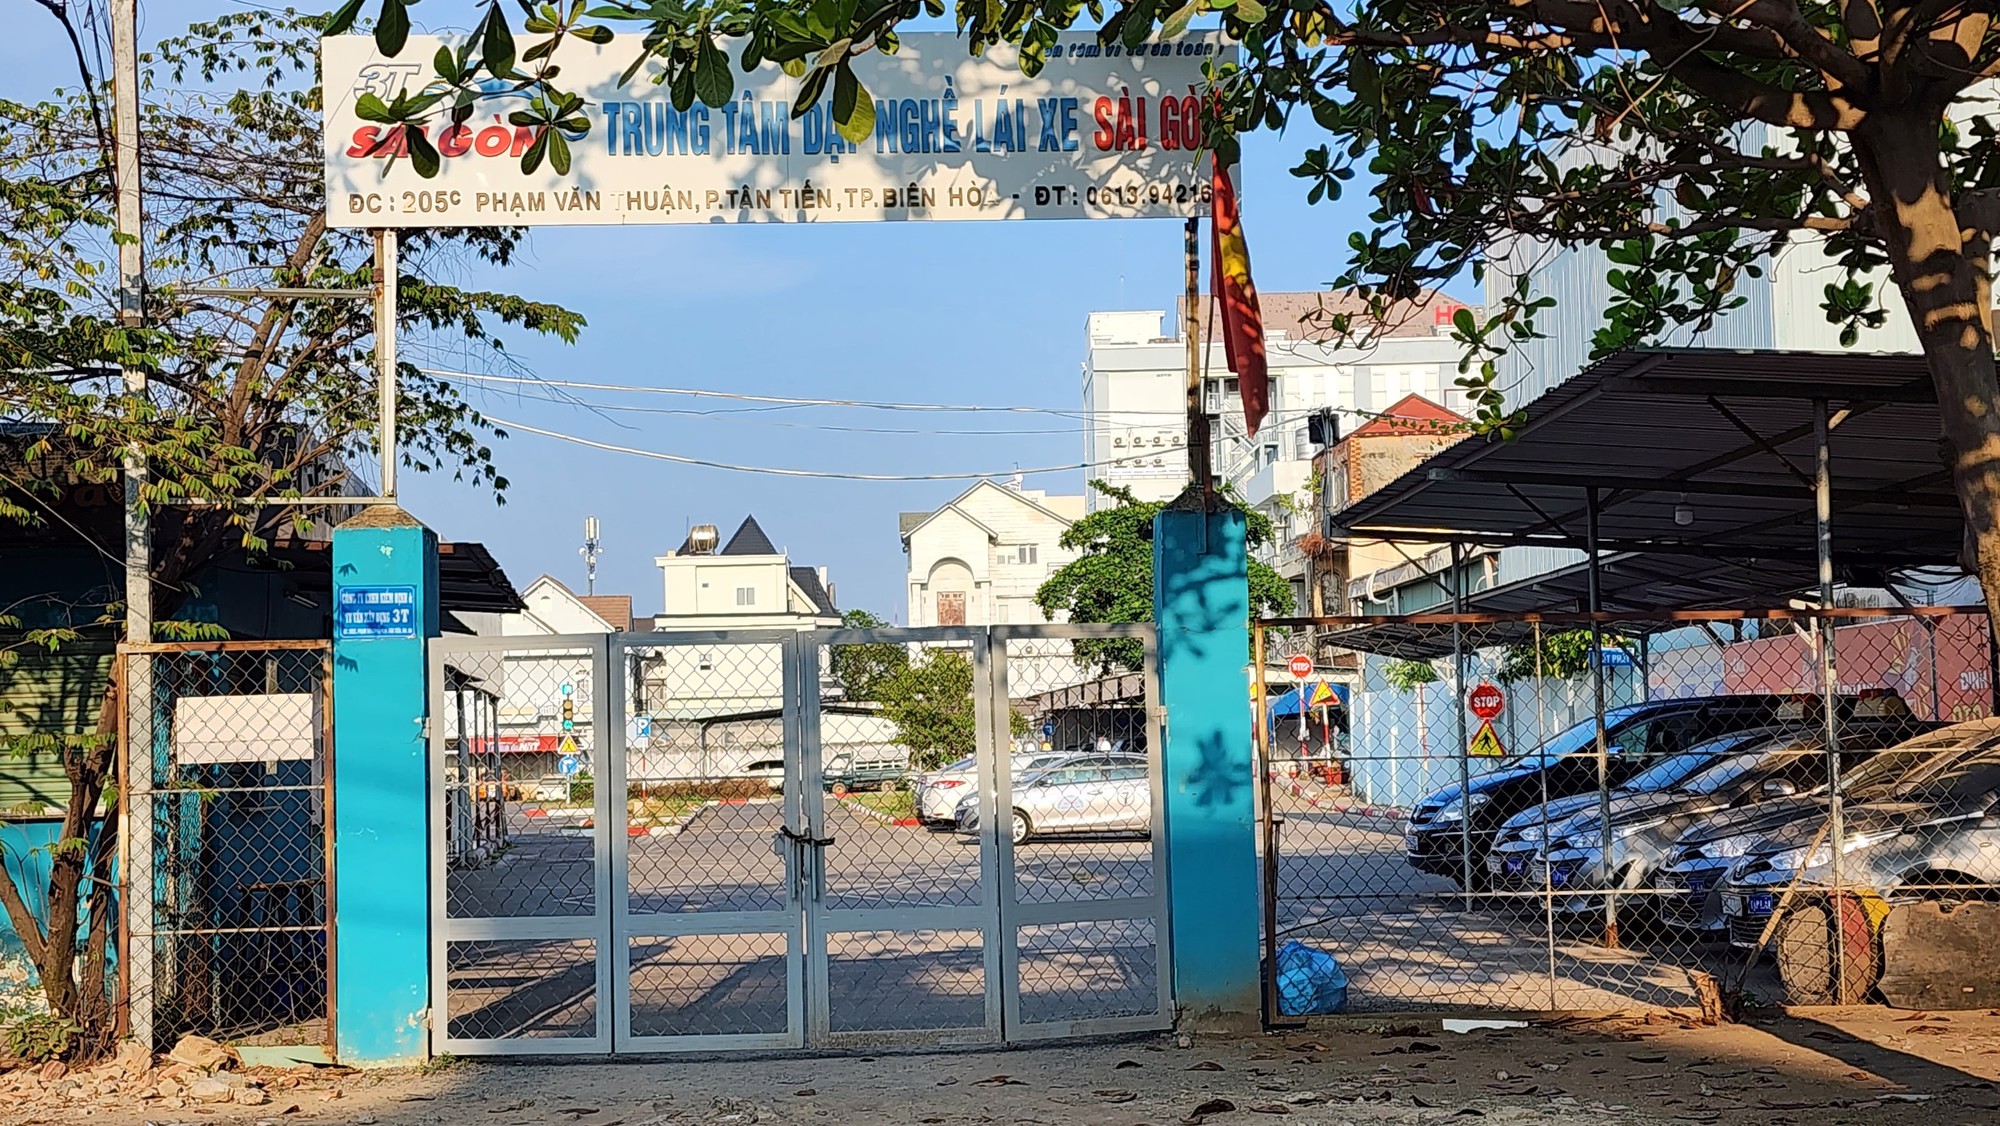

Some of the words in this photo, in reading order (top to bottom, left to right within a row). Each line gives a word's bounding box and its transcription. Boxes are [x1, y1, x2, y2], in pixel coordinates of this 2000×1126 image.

[602, 101, 710, 157] TRUNG
[721, 90, 791, 155] TÂM
[802, 100, 857, 164] DẠ
[875, 75, 962, 154] NGHỀ
[974, 85, 1026, 153] LÁI
[1037, 97, 1079, 152] XE
[1093, 87, 1148, 151] SÀI
[476, 191, 545, 217] PHẠM
[554, 185, 600, 212] VĂN
[392, 608, 410, 623] 3T
[1474, 696, 1500, 708] STOP
[637, 718, 649, 736] P
